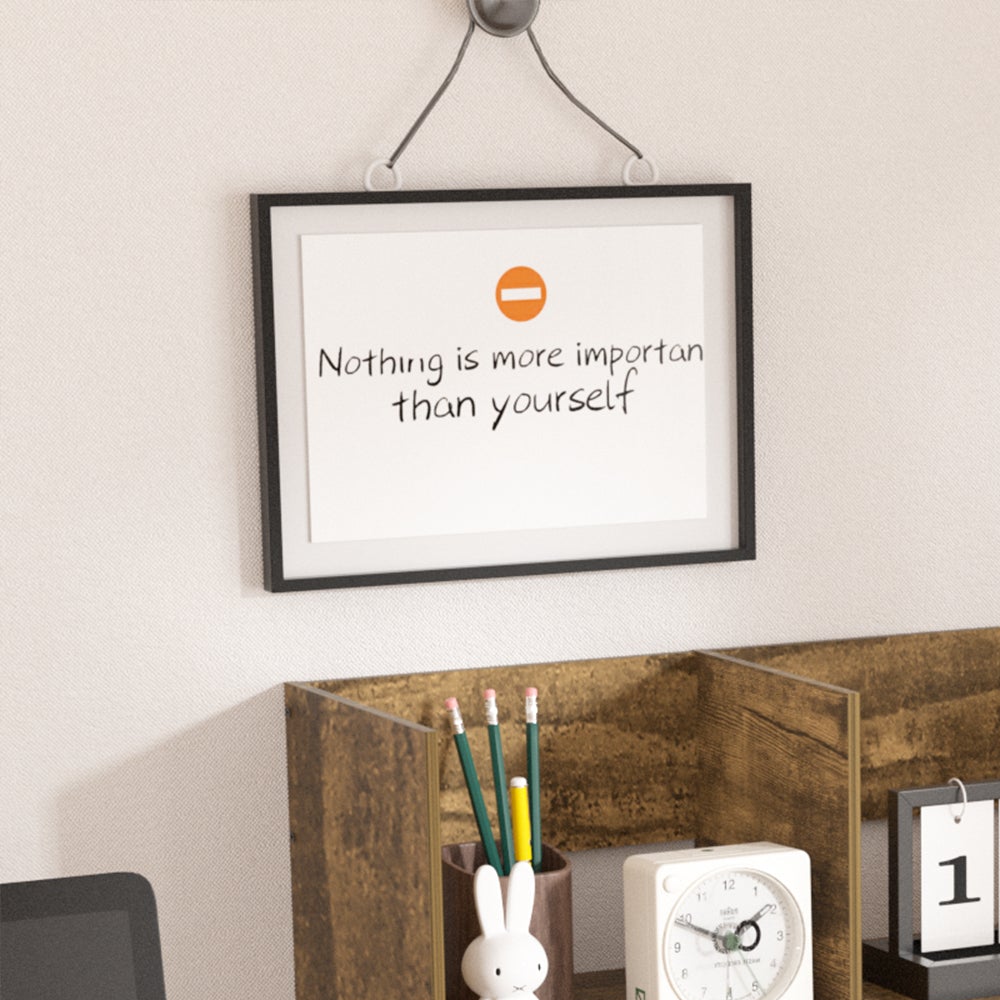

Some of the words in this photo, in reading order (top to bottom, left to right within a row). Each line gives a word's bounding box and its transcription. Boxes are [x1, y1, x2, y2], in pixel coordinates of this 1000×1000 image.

[317, 346, 444, 387] Nothing
[457, 347, 480, 371] is
[491, 349, 565, 370] more
[575, 339, 704, 376] importan
[392, 390, 477, 423] than
[491, 368, 638, 431] yourself
[723, 880, 735, 890] 12
[938, 855, 981, 906] 1
[777, 930, 784, 941] 3
[674, 942, 681, 953] 9
[682, 968, 688, 979] 8
